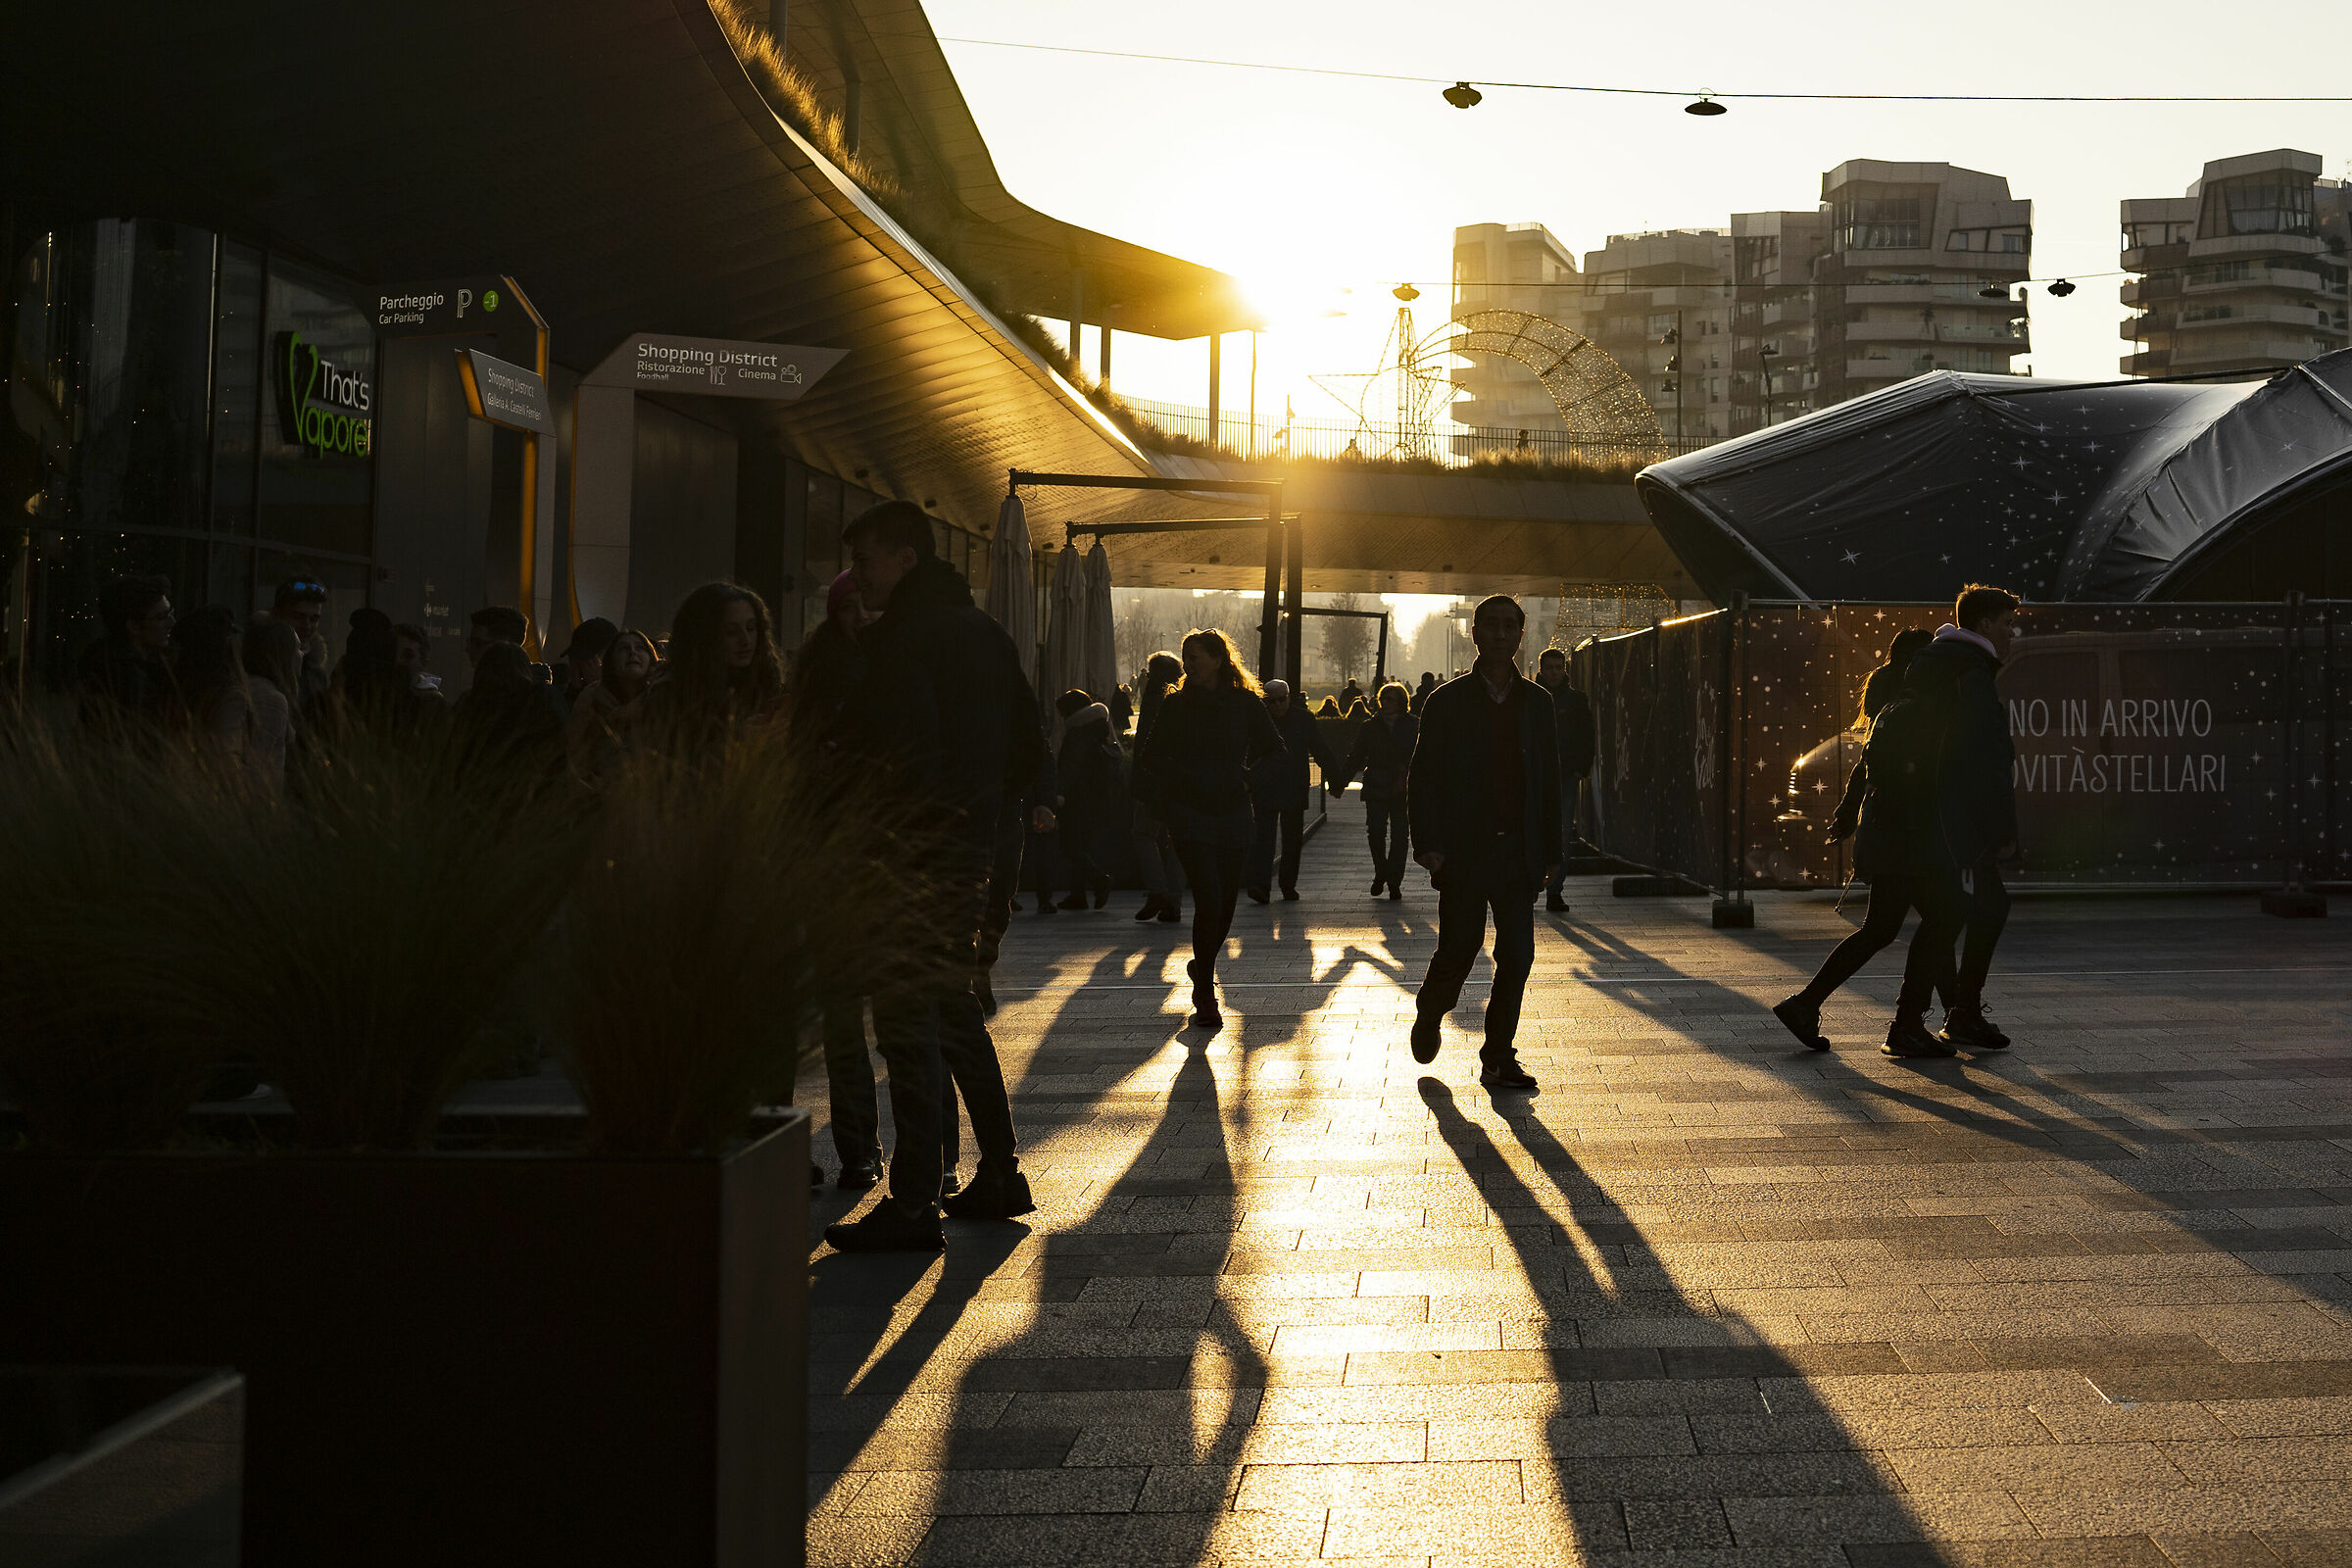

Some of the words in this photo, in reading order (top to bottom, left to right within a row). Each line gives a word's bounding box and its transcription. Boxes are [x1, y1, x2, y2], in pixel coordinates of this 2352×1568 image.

[379, 292, 444, 311] Parcheggio
[378, 314, 393, 324] Car
[394, 312, 424, 324] Parking
[637, 343, 714, 366] Shopping
[718, 350, 777, 368] District
[637, 361, 705, 375] Ristorazione
[637, 371, 669, 381] Foodhall
[738, 368, 776, 380] Cinema
[320, 361, 369, 411] That's
[488, 368, 514, 395] Shopping
[2010, 699, 2049, 737] NO
[2062, 699, 2086, 737] IN
[2100, 699, 2212, 737] ARRIVO
